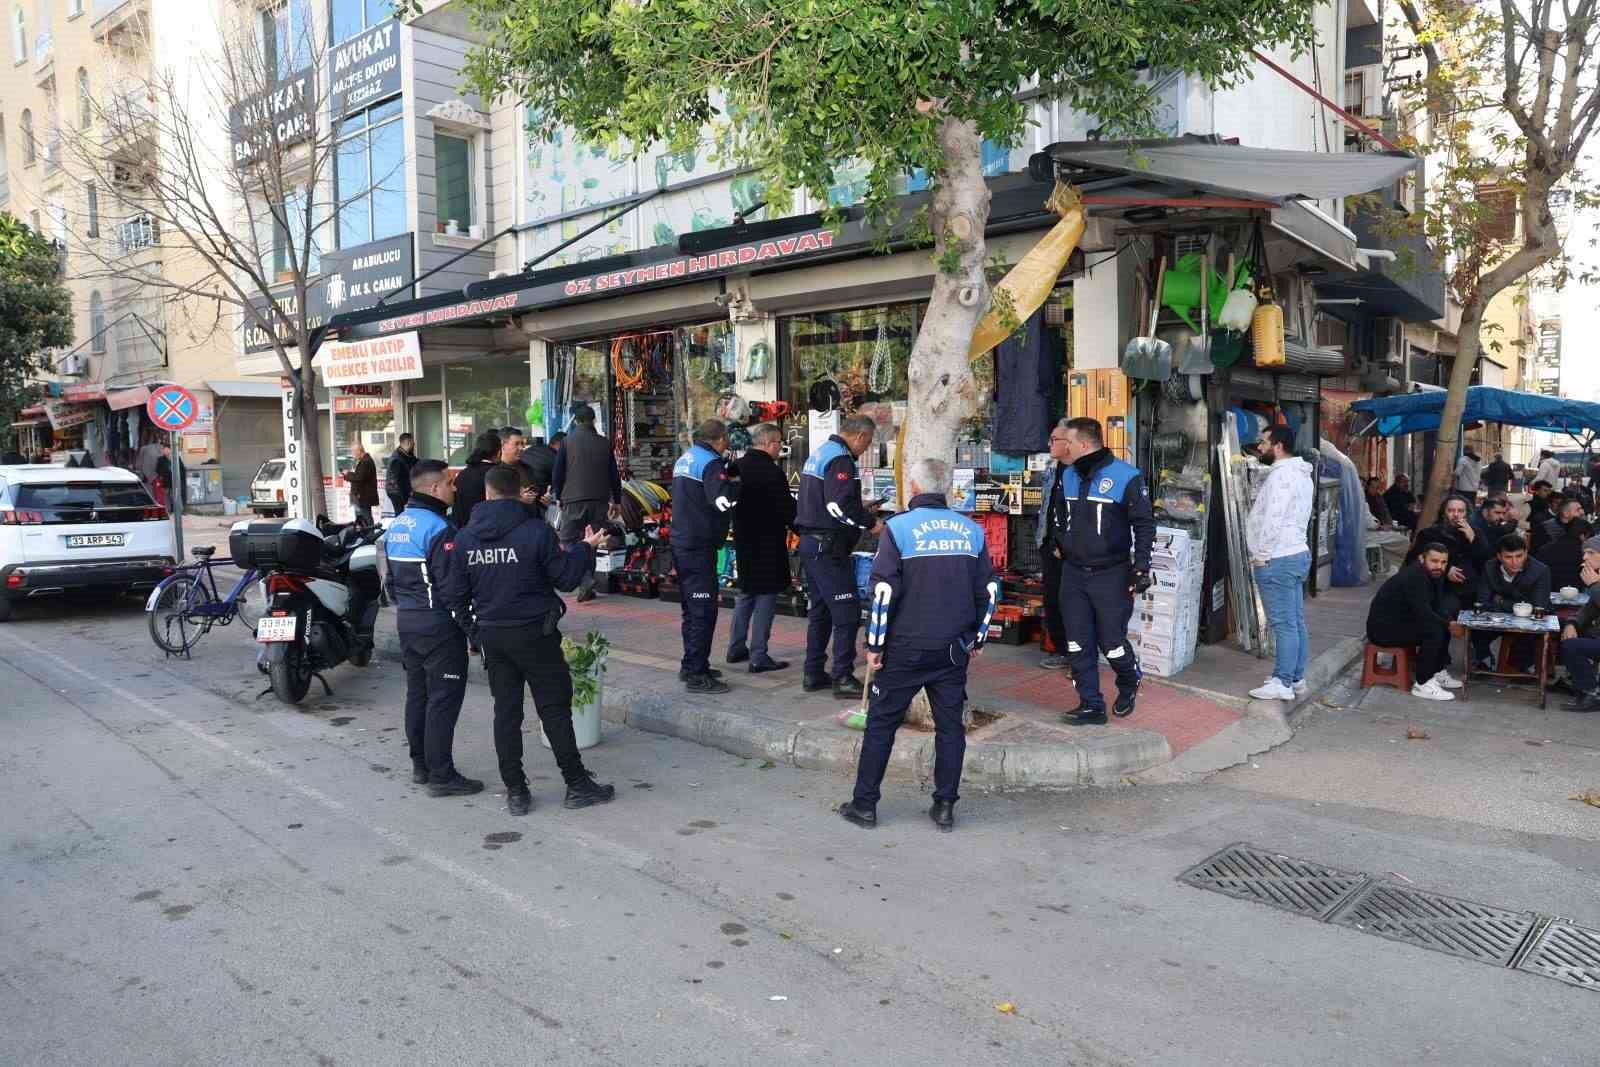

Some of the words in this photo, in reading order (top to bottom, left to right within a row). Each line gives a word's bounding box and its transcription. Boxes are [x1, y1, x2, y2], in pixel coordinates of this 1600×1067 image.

[335, 24, 393, 72] AVUKAT
[365, 54, 397, 80] DUYGU
[352, 248, 401, 271] ARABULUCU
[564, 279, 591, 296] ÖZ
[596, 260, 686, 290] SEYMEN
[689, 230, 834, 274] HIRDAVAT
[350, 284, 362, 297] AV.
[373, 275, 402, 292] CANAN
[426, 294, 518, 321] HIRDAVAT
[72, 536, 84, 545] 33
[87, 535, 104, 544] ARP
[105, 534, 122, 544] 543
[915, 539, 972, 552] ZABITA
[467, 548, 519, 566] ZABITA
